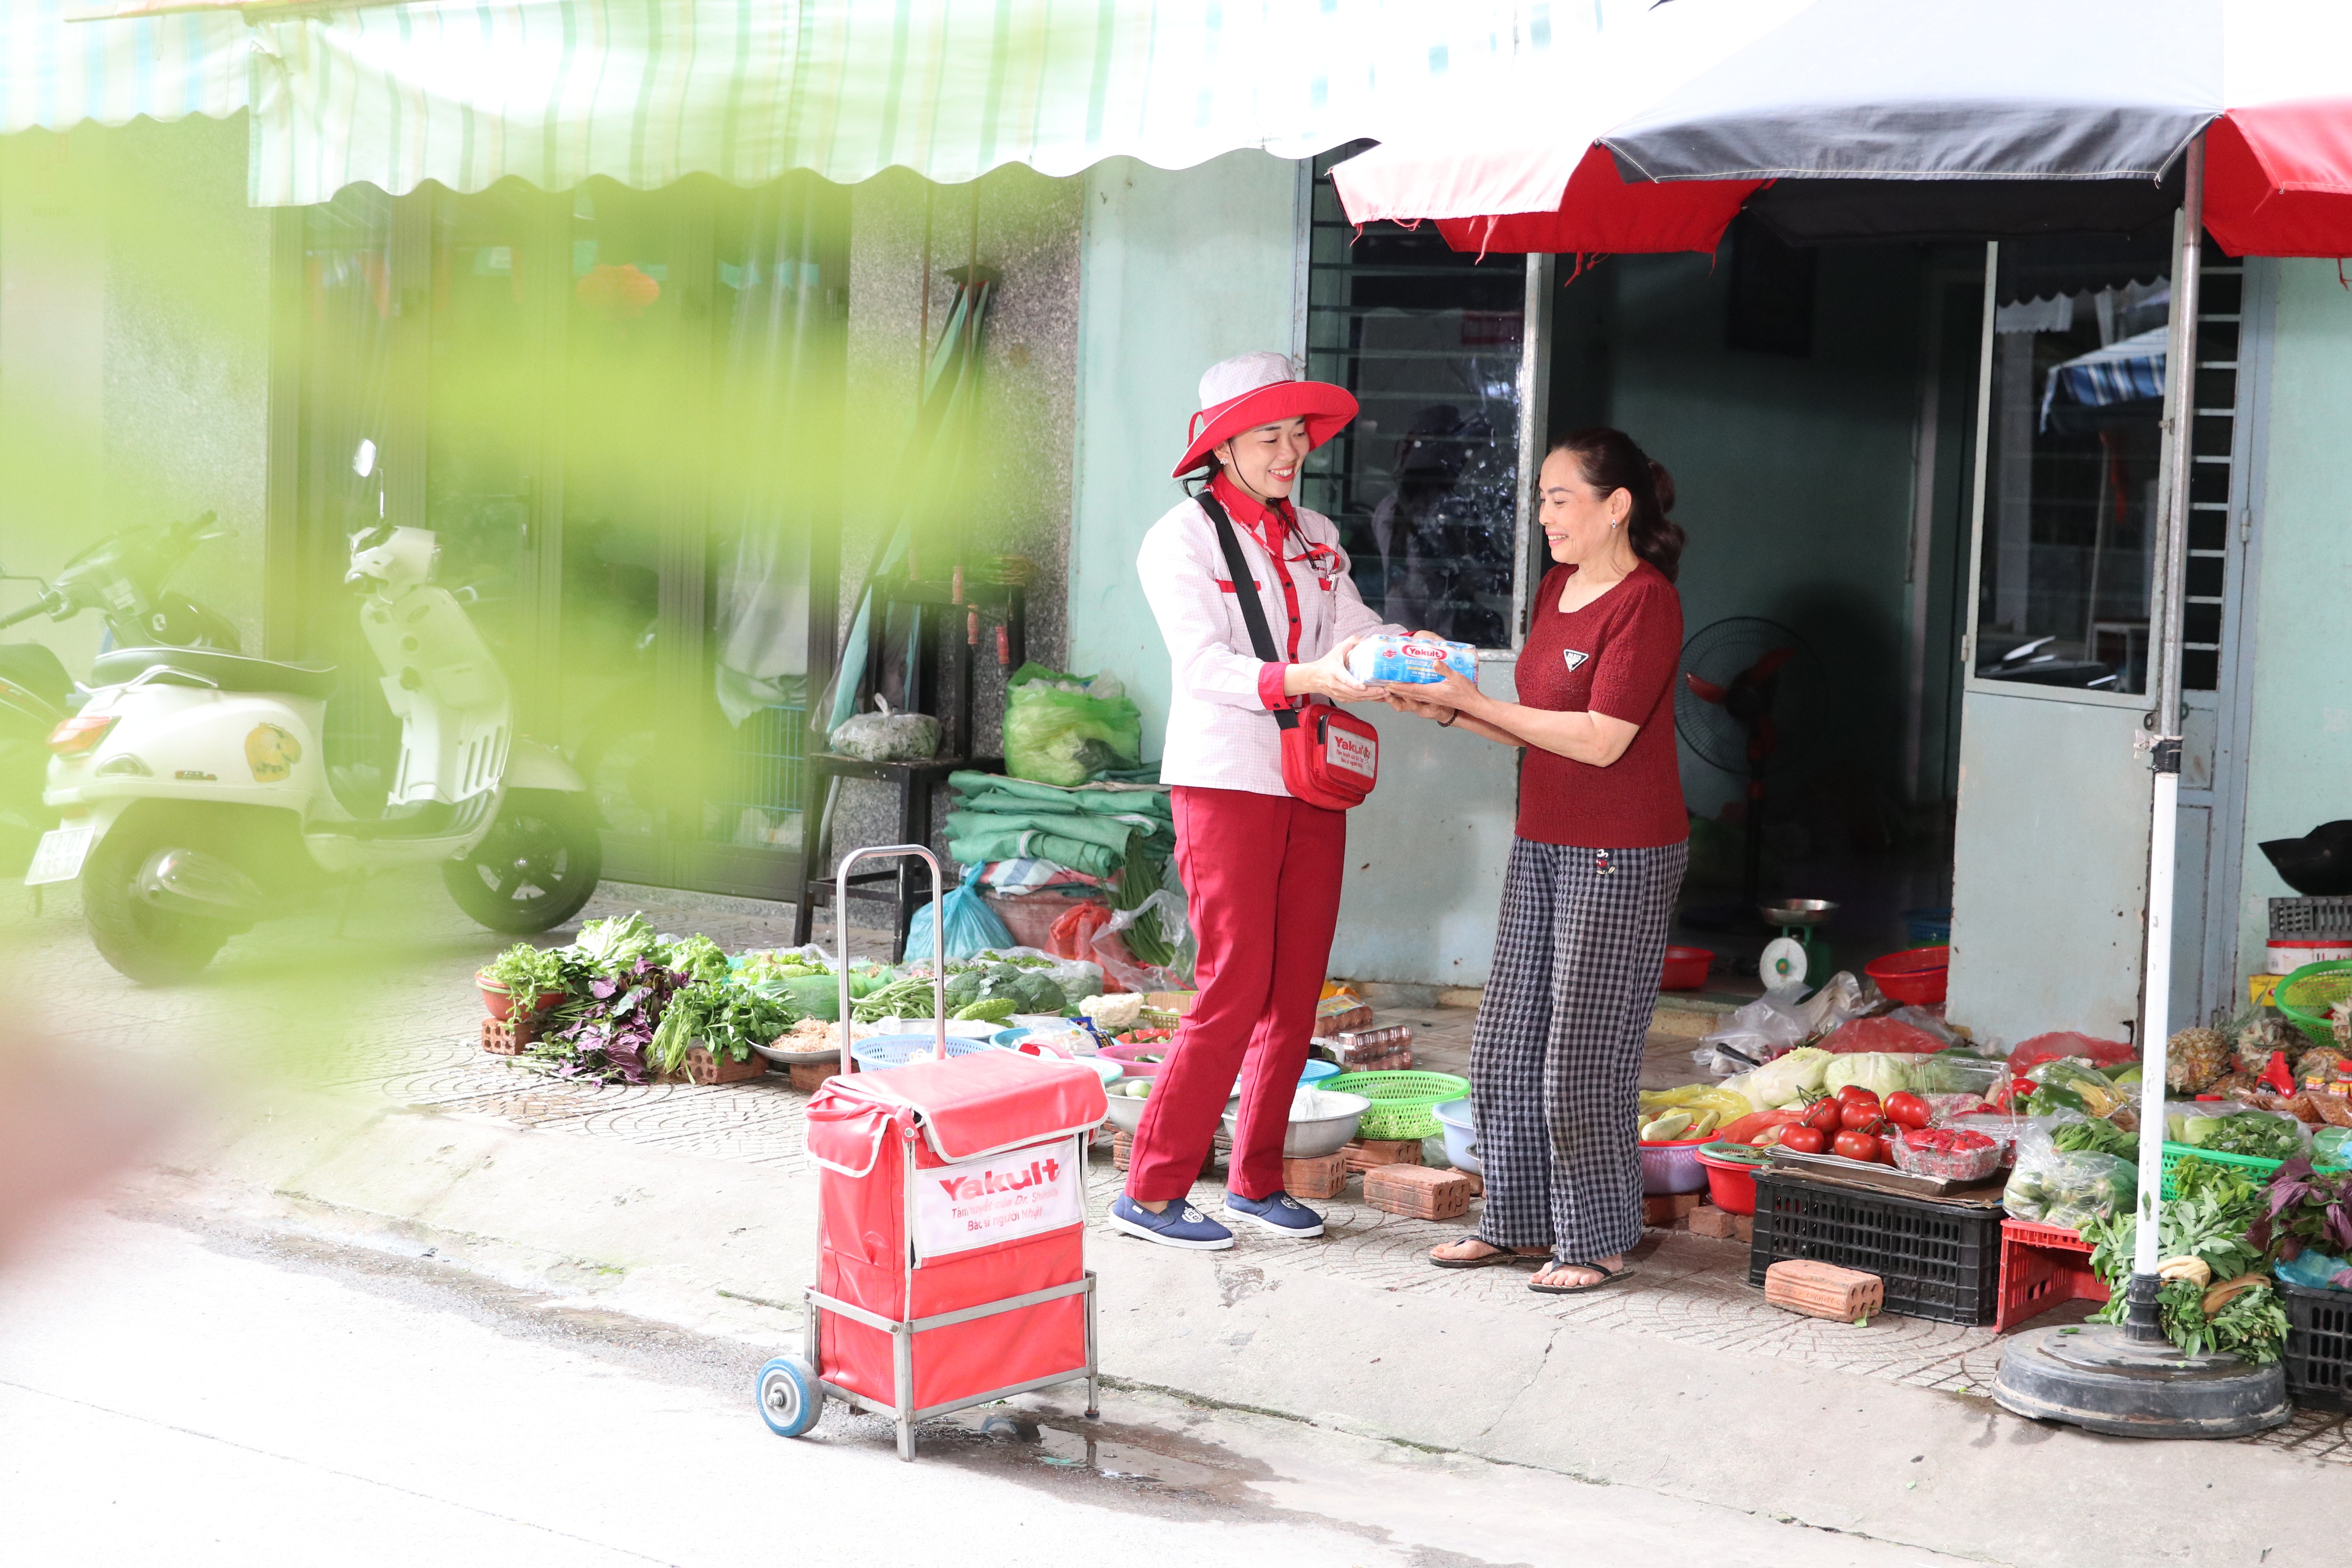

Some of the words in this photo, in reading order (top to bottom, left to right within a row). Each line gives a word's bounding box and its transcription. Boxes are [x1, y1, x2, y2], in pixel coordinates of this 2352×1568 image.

[1219, 499, 1230, 513] Yakult
[1240, 521, 1252, 534] Yakult
[1263, 543, 1275, 556] Yakult
[1409, 647, 1440, 658] Yakult
[1334, 735, 1370, 760] Yakult
[938, 1158, 1061, 1202] Yakult
[951, 1206, 969, 1219] Tâm
[1015, 1195, 1028, 1205] Dr.
[1032, 1188, 1059, 1203] Shirota
[967, 1218, 983, 1231] Bác
[993, 1210, 1020, 1226] người
[1021, 1206, 1043, 1219] Nhật
